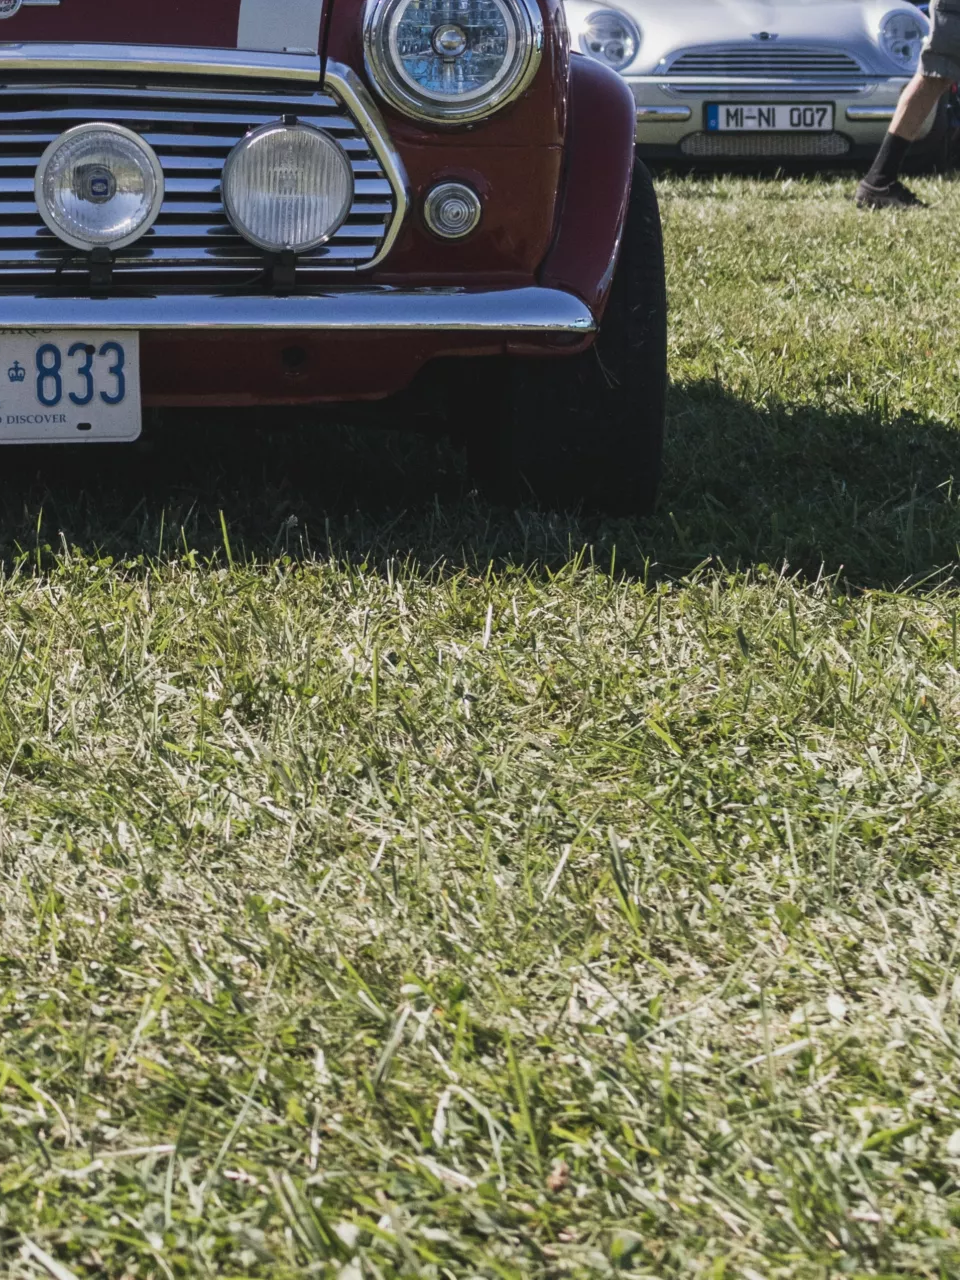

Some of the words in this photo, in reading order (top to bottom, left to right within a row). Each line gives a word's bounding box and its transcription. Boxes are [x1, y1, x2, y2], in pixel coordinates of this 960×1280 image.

[726, 107, 776, 128] MI-NI
[790, 107, 828, 128] 007
[35, 341, 126, 407] 833
[6, 414, 67, 424] DISCOVER
